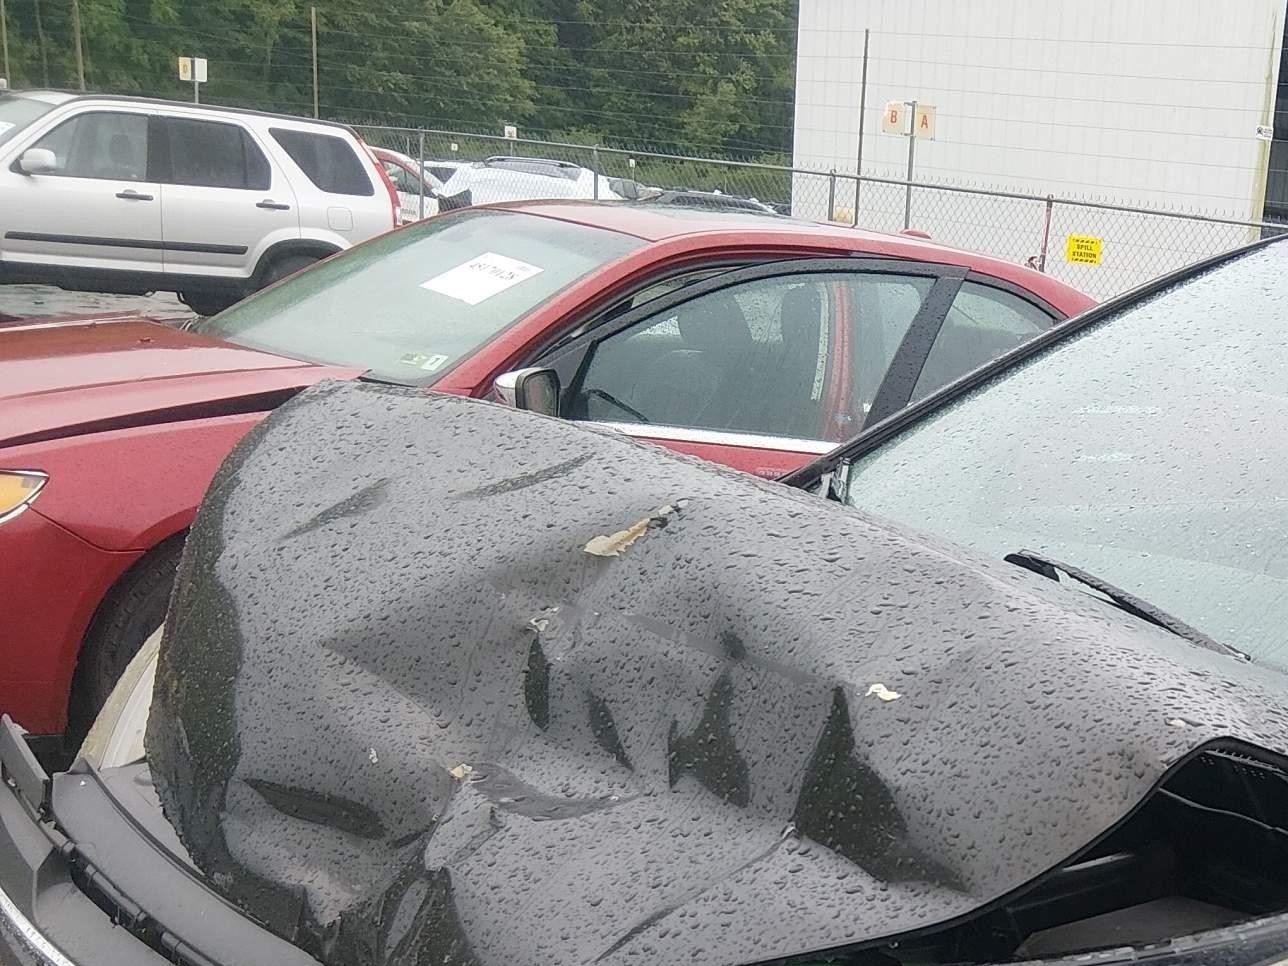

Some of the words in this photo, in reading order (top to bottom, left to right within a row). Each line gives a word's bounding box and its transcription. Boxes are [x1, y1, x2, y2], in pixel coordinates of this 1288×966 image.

[890, 110, 898, 124] B
[920, 114, 929, 129] A
[1076, 243, 1094, 251] SPILL
[1072, 251, 1097, 259] STATION
